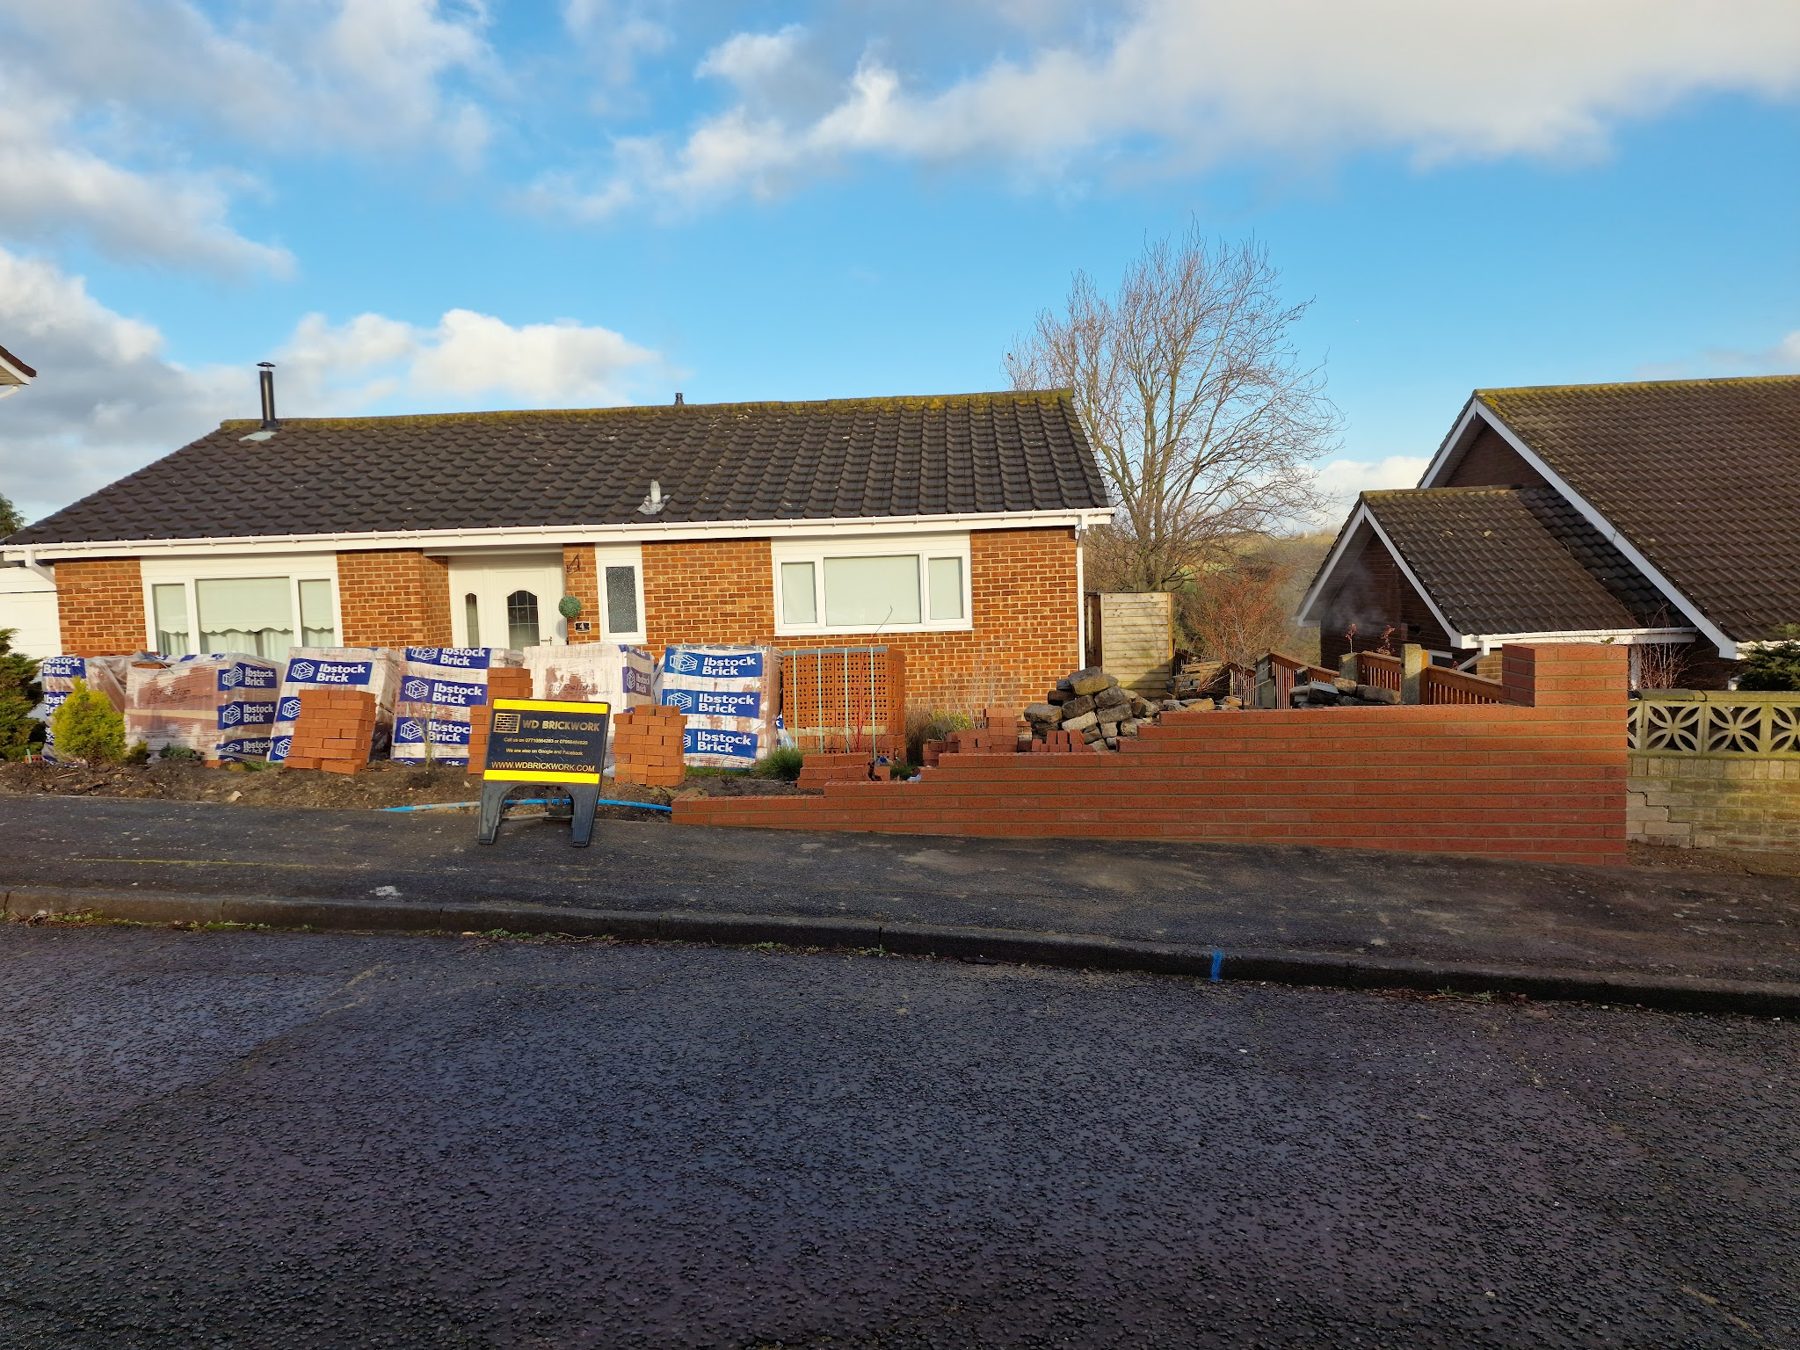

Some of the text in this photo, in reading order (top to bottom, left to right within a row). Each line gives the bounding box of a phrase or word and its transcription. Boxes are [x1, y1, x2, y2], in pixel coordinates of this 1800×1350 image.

[442, 648, 486, 657] Ibstock
[440, 655, 470, 665] Brick
[704, 656, 756, 667] Ibstock
[43, 664, 71, 674] Brick
[245, 667, 273, 677] Ibstock
[319, 663, 366, 673] Ibstock
[702, 666, 739, 675] Brick
[245, 677, 265, 686] Brick
[316, 672, 349, 682] Brick
[434, 682, 482, 696] Ibstock
[432, 692, 466, 704] Brick
[699, 693, 754, 705] Ibstock
[243, 704, 273, 713] Ibstock
[698, 703, 736, 713] Brick
[243, 714, 264, 722] Brick
[523, 720, 600, 732] WD BRICKWORK
[428, 732, 461, 742] Brick
[697, 731, 751, 745] Ibstock
[697, 741, 733, 753] Brick
[491, 761, 595, 772] WWW.WDBRICKWORK.COM
